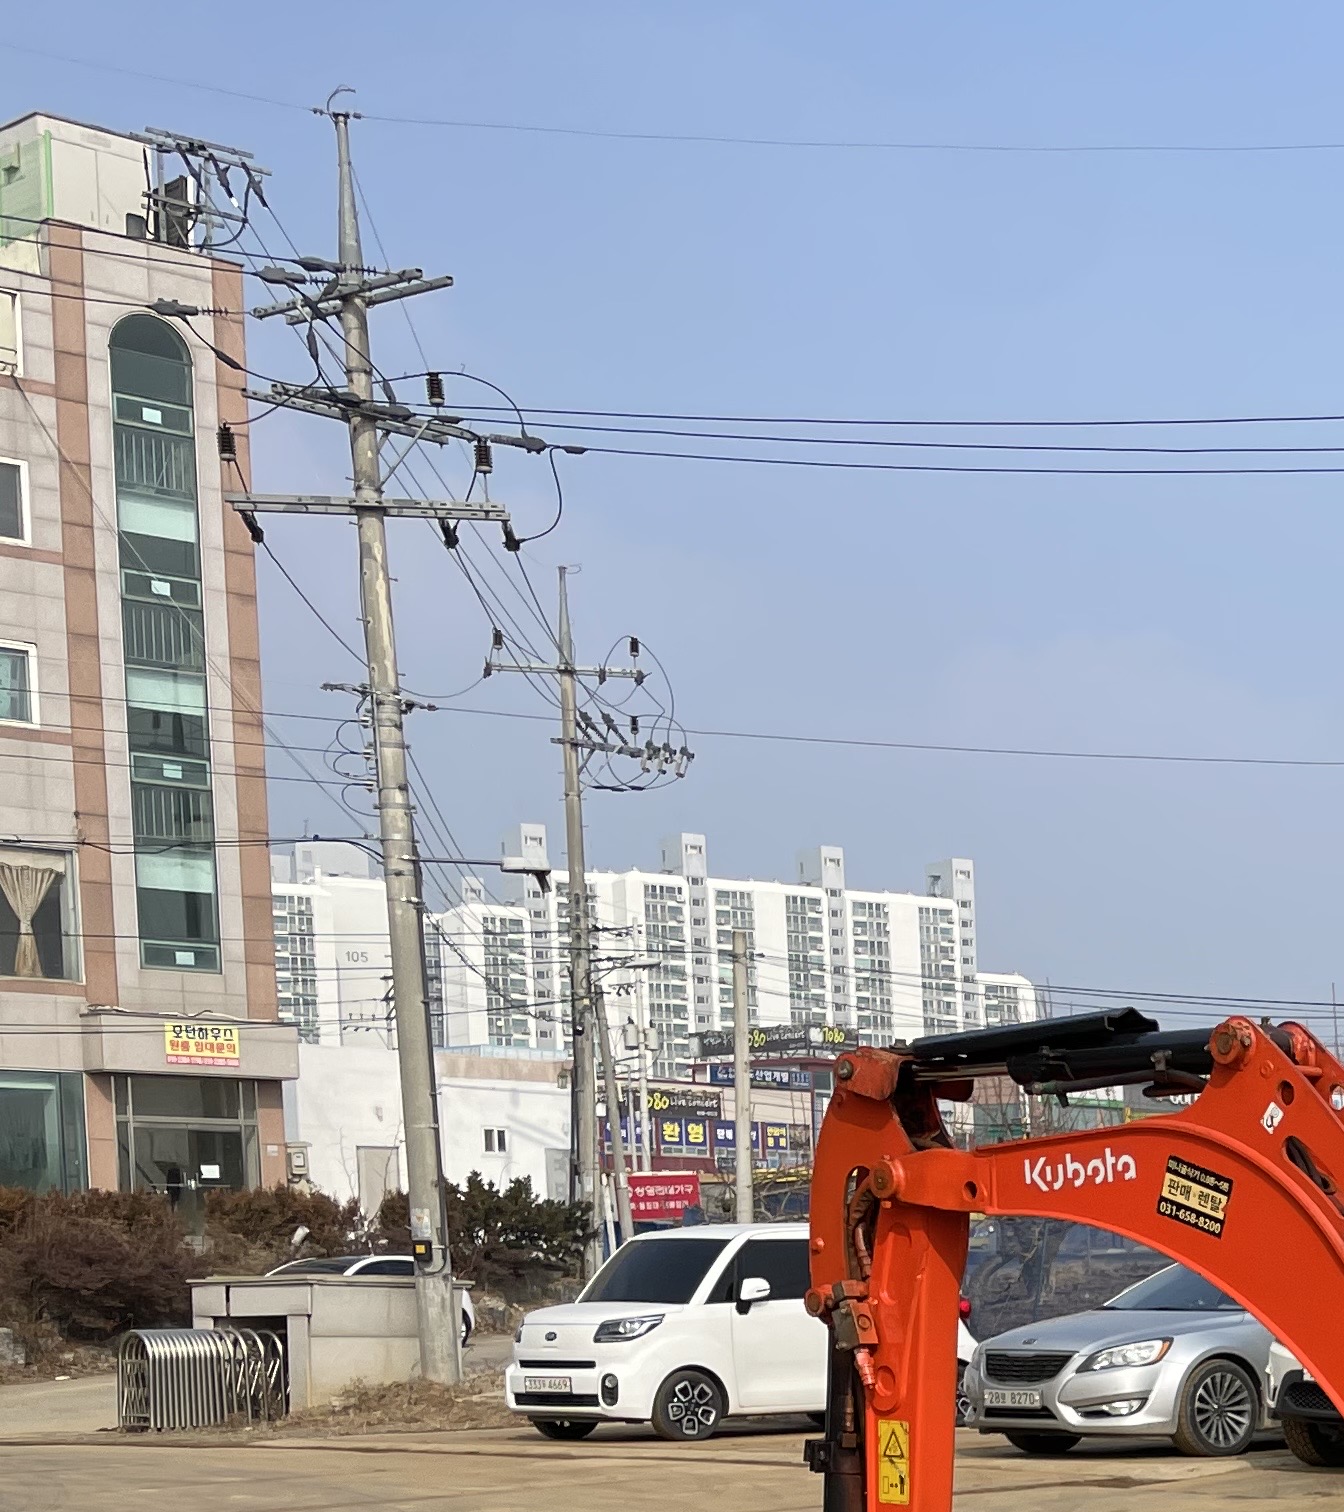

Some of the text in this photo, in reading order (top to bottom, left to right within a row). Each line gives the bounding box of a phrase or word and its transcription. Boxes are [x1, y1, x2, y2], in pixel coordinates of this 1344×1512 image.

[345, 951, 368, 962] 105
[747, 1028, 766, 1048] 080
[647, 1092, 670, 1110] 080
[1024, 1147, 1137, 1192] Kubota
[1167, 1178, 1222, 1214] 판매 렌탈
[1159, 1201, 1221, 1234] 031-658-8200
[1010, 1391, 1036, 1406] 8270
